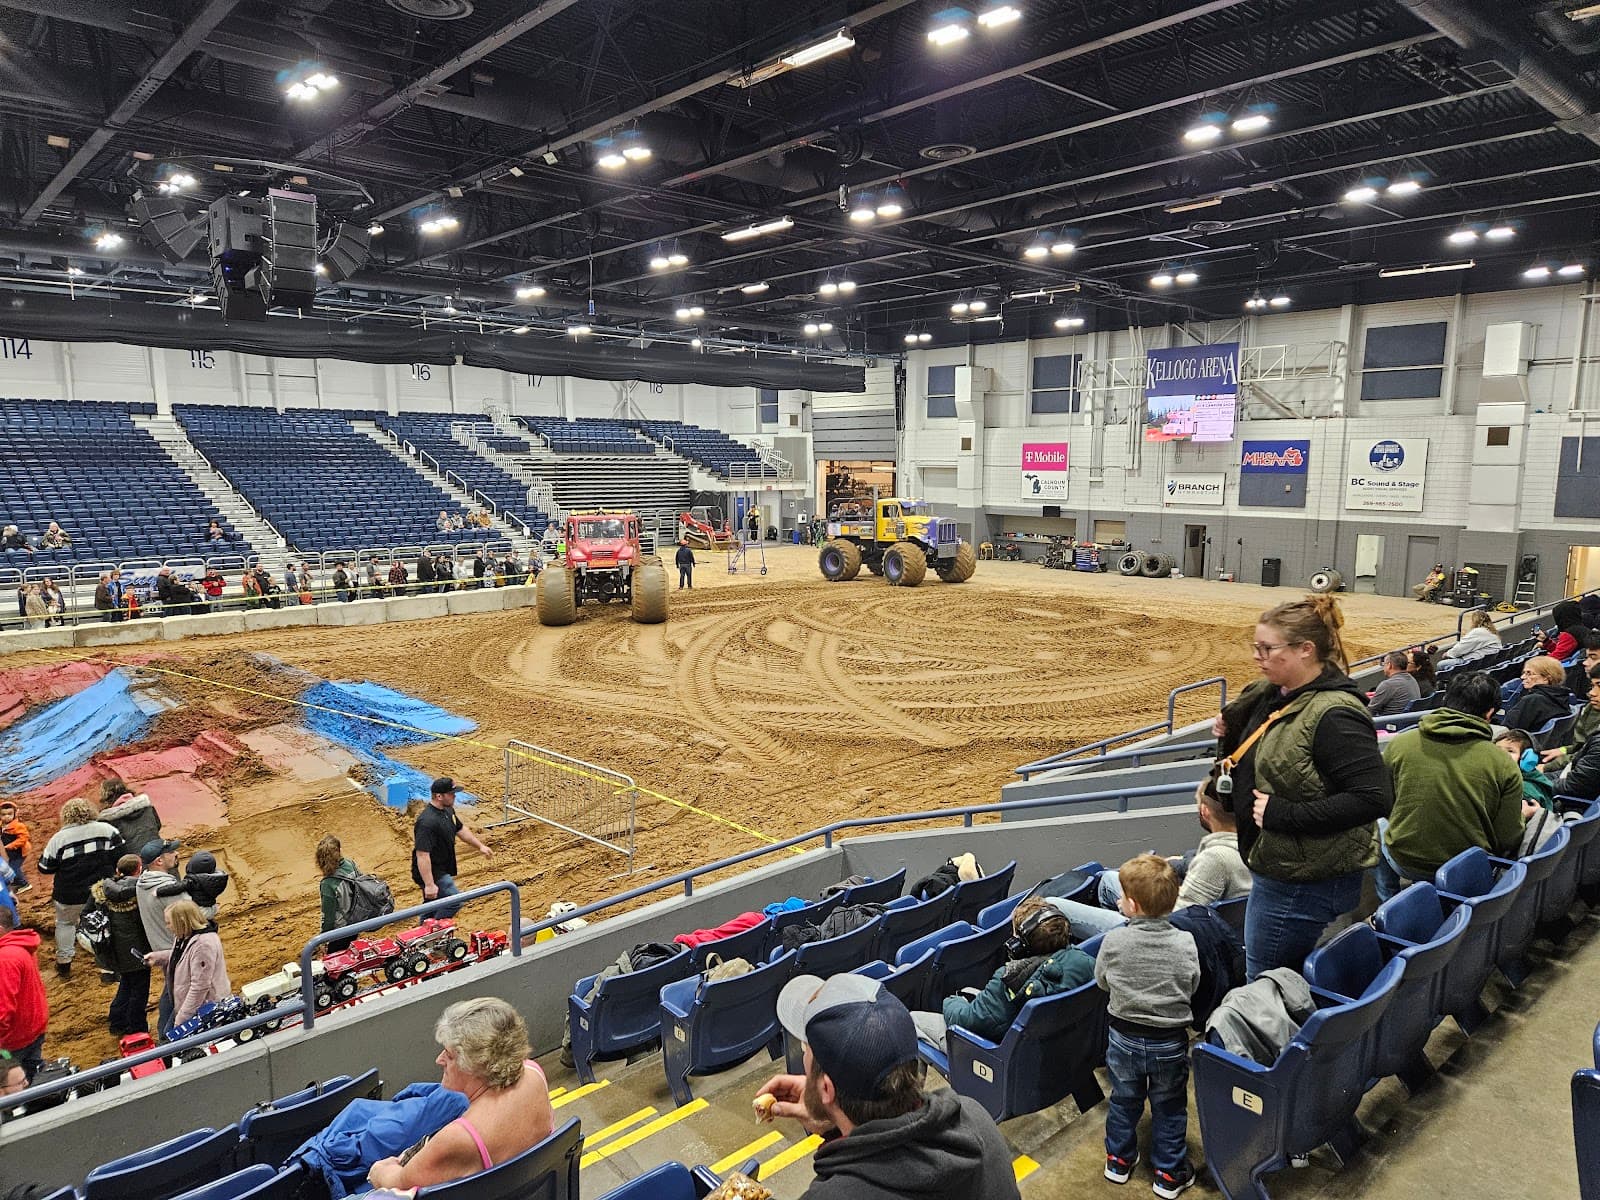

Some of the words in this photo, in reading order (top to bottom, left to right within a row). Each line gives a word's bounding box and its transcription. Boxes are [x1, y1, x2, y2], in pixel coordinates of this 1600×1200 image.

[0, 338, 33, 359] 114
[1146, 358, 1197, 389] KELLOGG
[1198, 352, 1238, 385] ARENA
[1034, 451, 1066, 463] Mobile
[1178, 483, 1220, 491] BRANCH
[1351, 478, 1366, 486] BC
[979, 1066, 987, 1077] D
[1243, 1093, 1253, 1108] E
